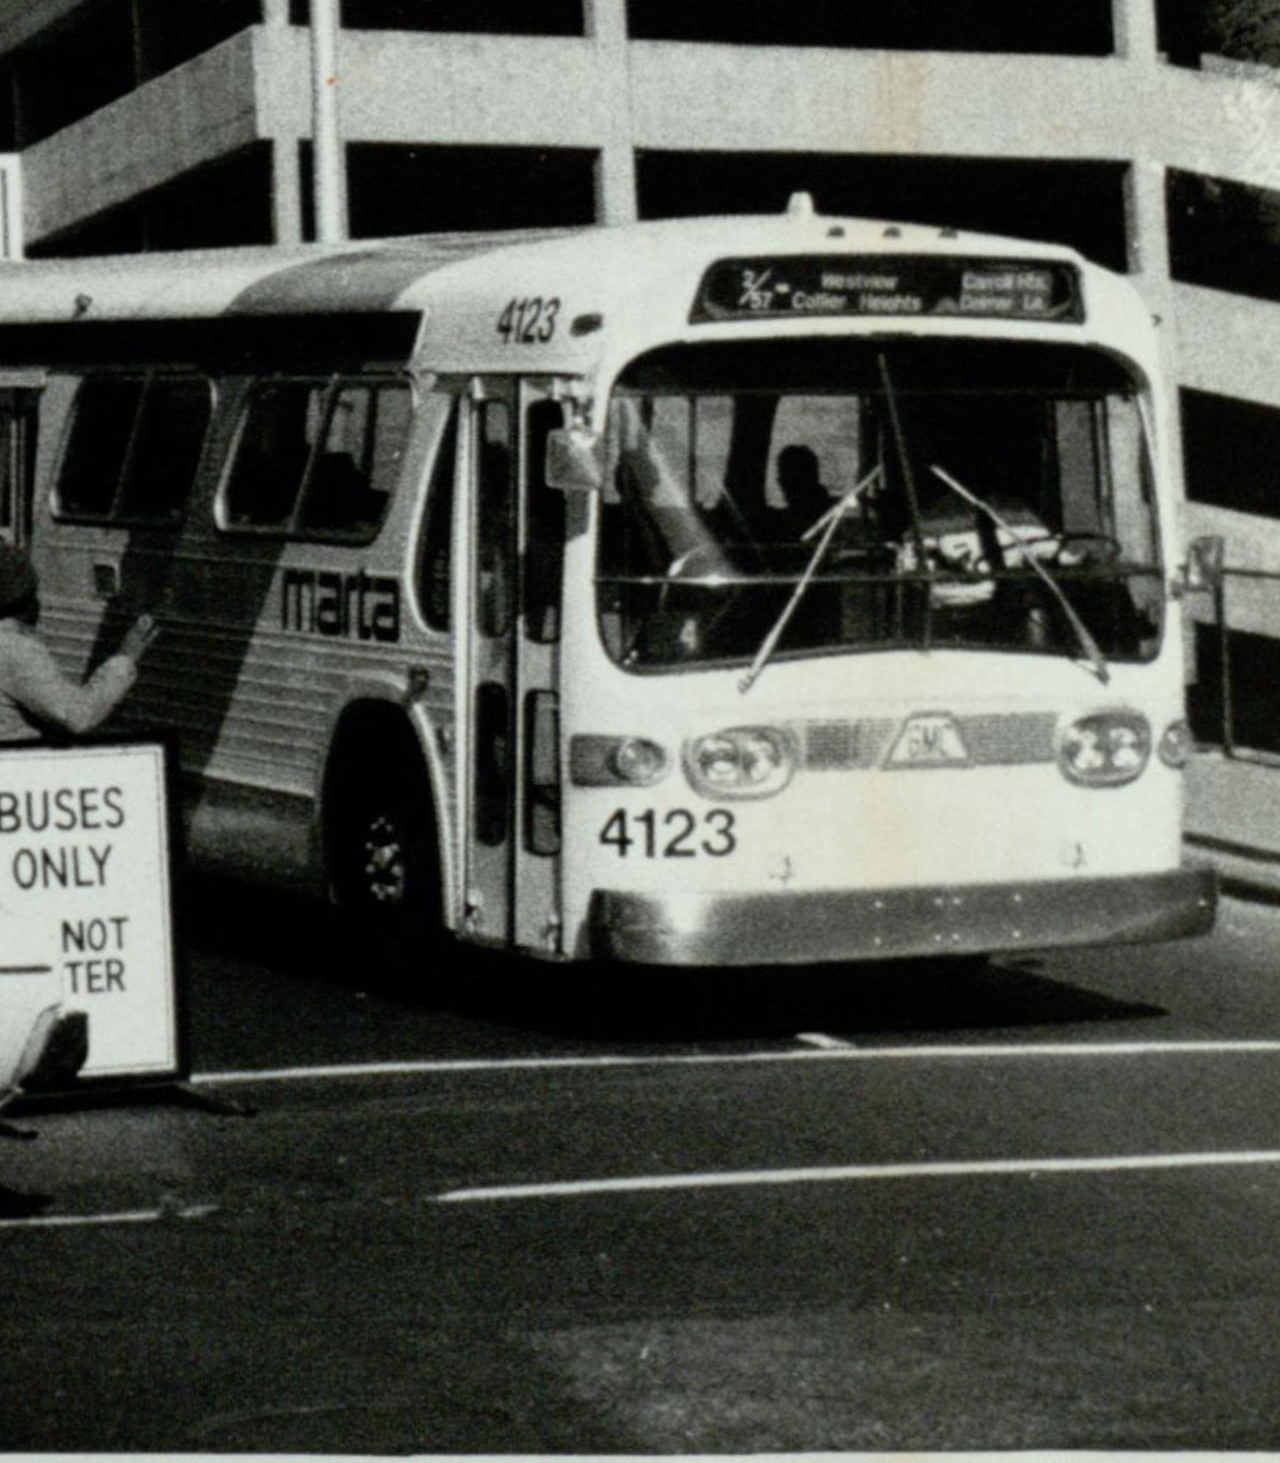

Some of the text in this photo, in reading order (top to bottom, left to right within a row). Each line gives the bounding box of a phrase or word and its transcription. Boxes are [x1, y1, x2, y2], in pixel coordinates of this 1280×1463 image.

[496, 296, 561, 344] 4123
[281, 568, 401, 643] marta
[599, 809, 737, 858] 4123
[12, 843, 113, 890] ONLY
[61, 915, 130, 953] NOT
[63, 958, 127, 994] TER
